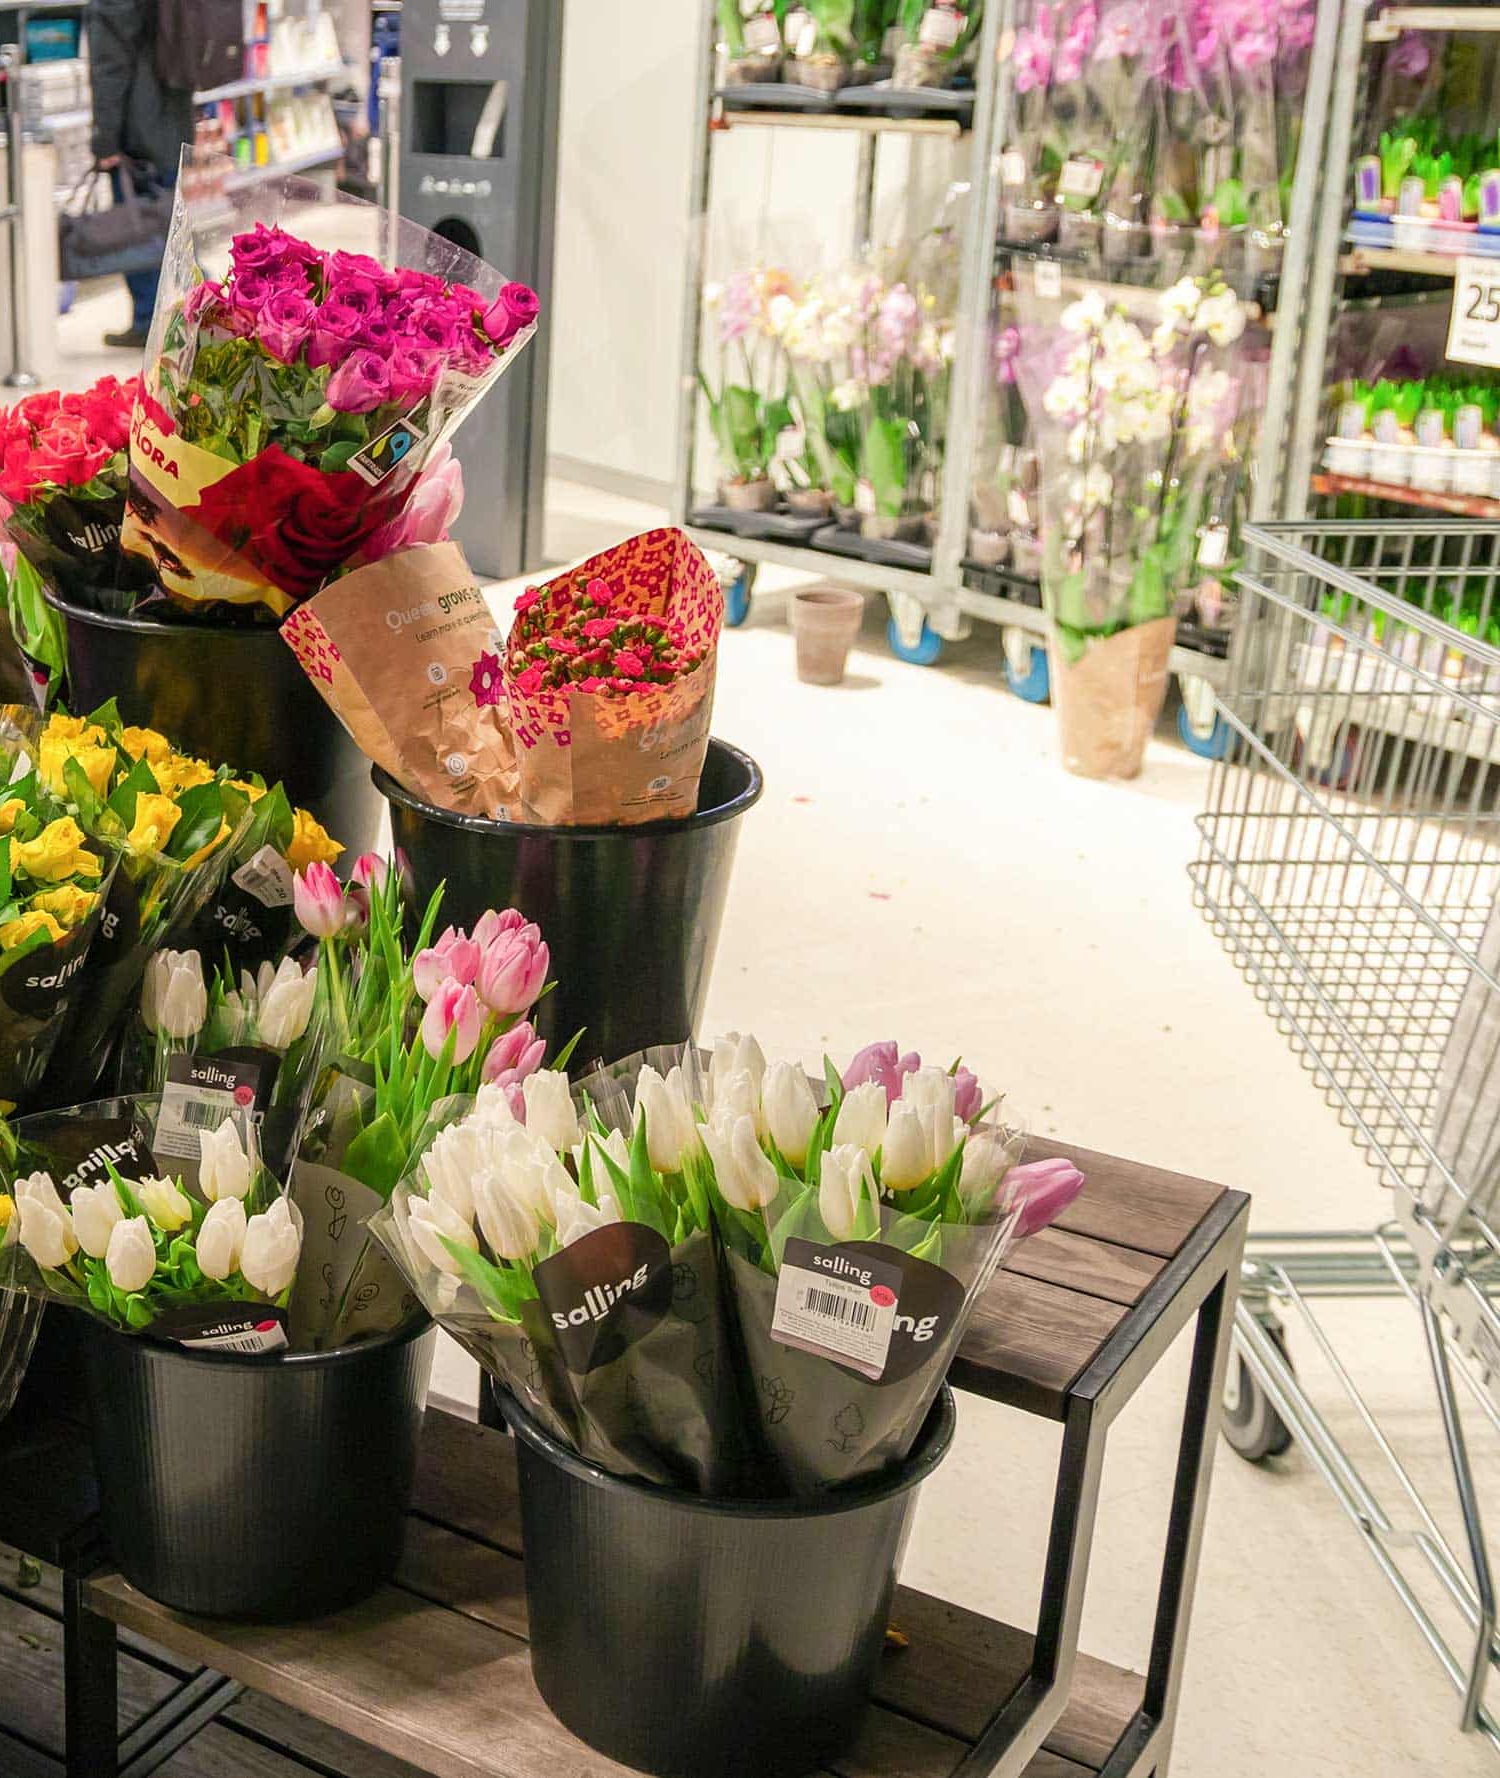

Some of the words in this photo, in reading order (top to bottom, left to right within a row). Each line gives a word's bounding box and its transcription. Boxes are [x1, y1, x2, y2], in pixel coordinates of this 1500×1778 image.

[67, 522, 121, 552] sallin
[190, 1066, 237, 1090] salling
[824, 1254, 873, 1286] salling
[551, 1263, 649, 1329] salling
[201, 1321, 254, 1337] salling
